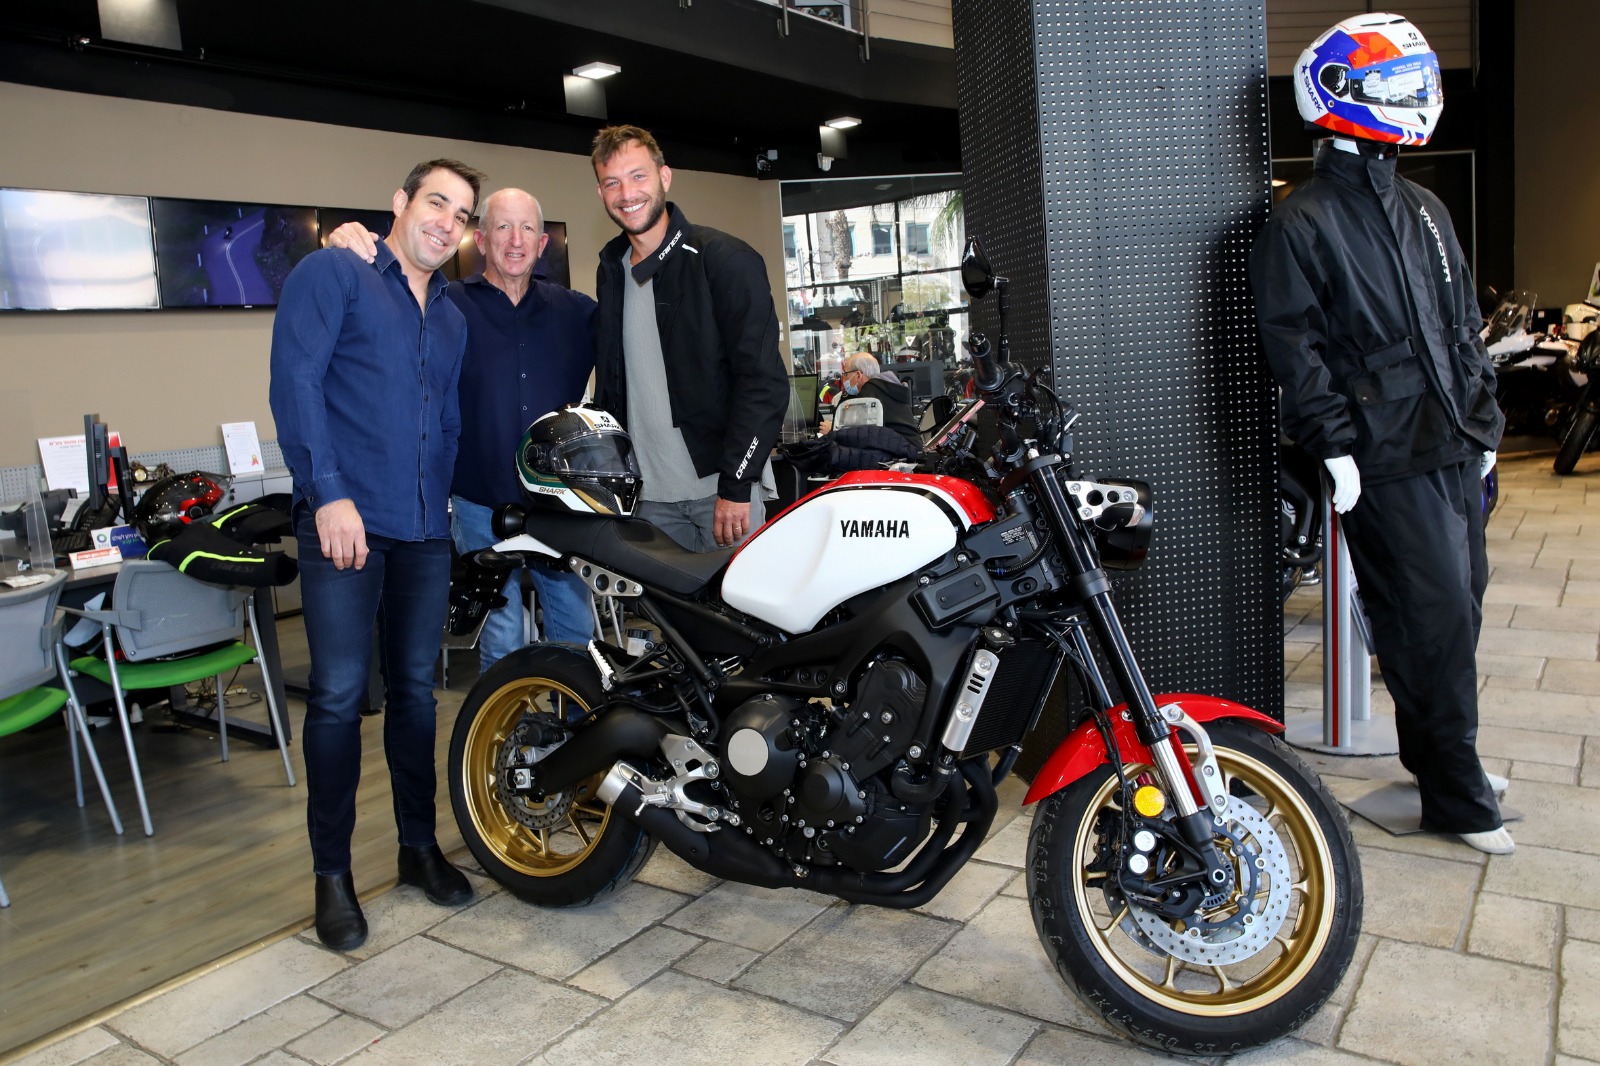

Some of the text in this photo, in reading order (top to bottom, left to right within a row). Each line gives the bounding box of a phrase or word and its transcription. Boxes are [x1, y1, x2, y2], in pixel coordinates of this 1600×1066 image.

[1304, 76, 1323, 113] SHARK
[658, 229, 683, 261] DAINESE
[735, 435, 760, 480] DAINESE
[538, 486, 566, 495] SHARK
[840, 519, 910, 538] YAMAHA
